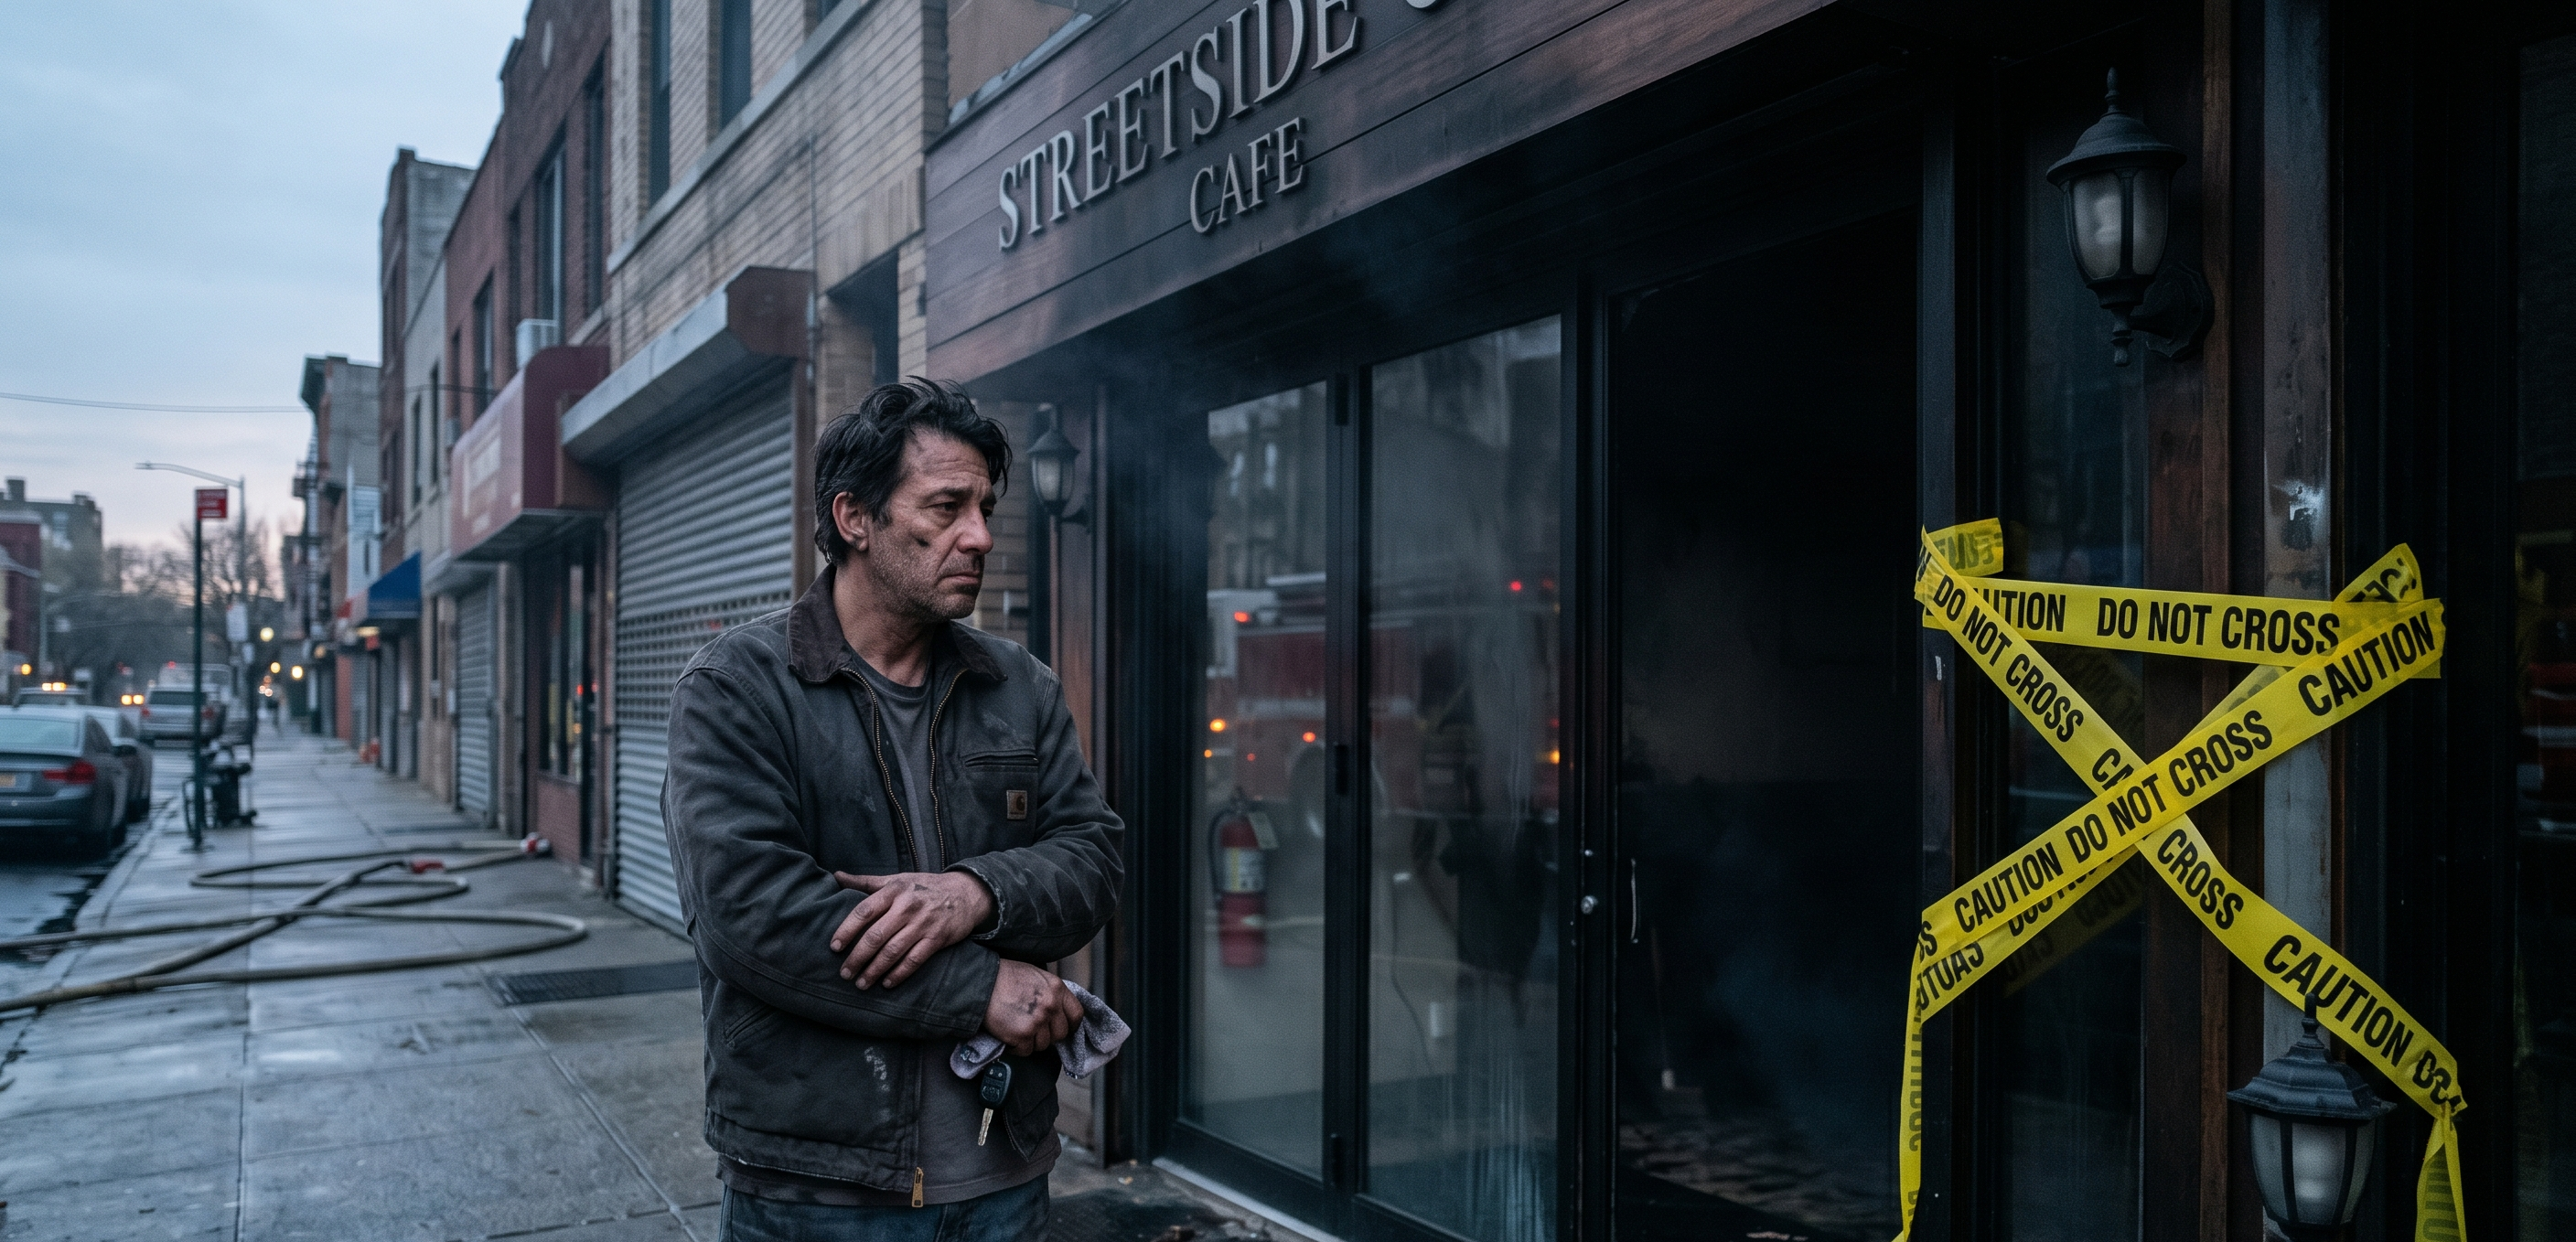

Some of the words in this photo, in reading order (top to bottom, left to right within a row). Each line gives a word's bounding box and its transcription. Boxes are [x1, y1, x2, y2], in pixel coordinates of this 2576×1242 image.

[999, 0, 1357, 252] STREETSIDE
[1190, 117, 1304, 233] CAFE
[1933, 574, 1966, 622] DO
[1961, 605, 2012, 667] NOT
[2005, 653, 2084, 743] CROSS
[2097, 597, 2139, 639] DO
[2148, 601, 2213, 646] NOT
[2221, 605, 2340, 657] CROSS
[1954, 841, 2065, 933] CAUTION
[2065, 813, 2109, 864] DO
[2107, 773, 2167, 837] NOT
[2168, 710, 2273, 798] CROSS
[2298, 610, 2436, 717] CAUTION
[2157, 829, 2244, 930] CROSS
[2263, 935, 2415, 1068] CAUTION
